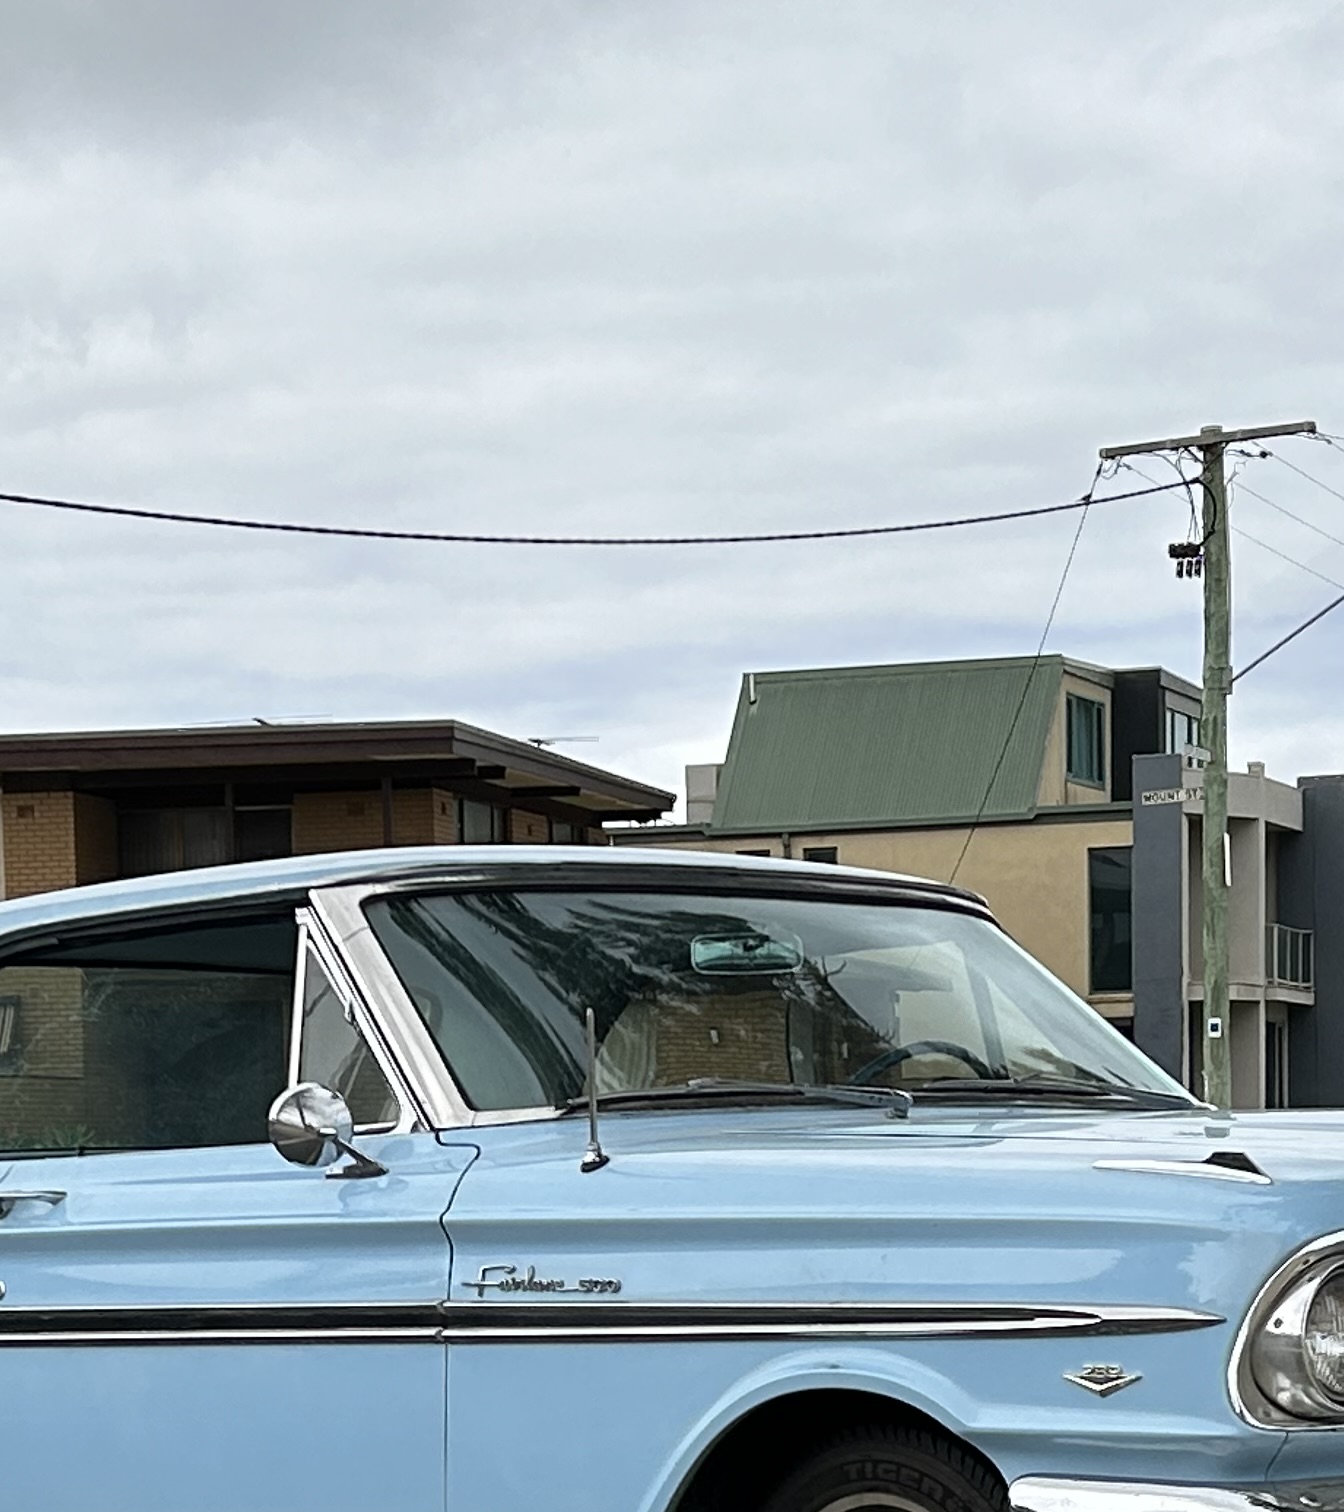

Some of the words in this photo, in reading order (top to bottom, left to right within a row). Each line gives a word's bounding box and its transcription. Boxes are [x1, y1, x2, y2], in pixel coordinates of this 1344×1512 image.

[1143, 791, 1180, 805] MOUNT
[577, 1279, 623, 1294] 500
[841, 1460, 945, 1505] TIGER
